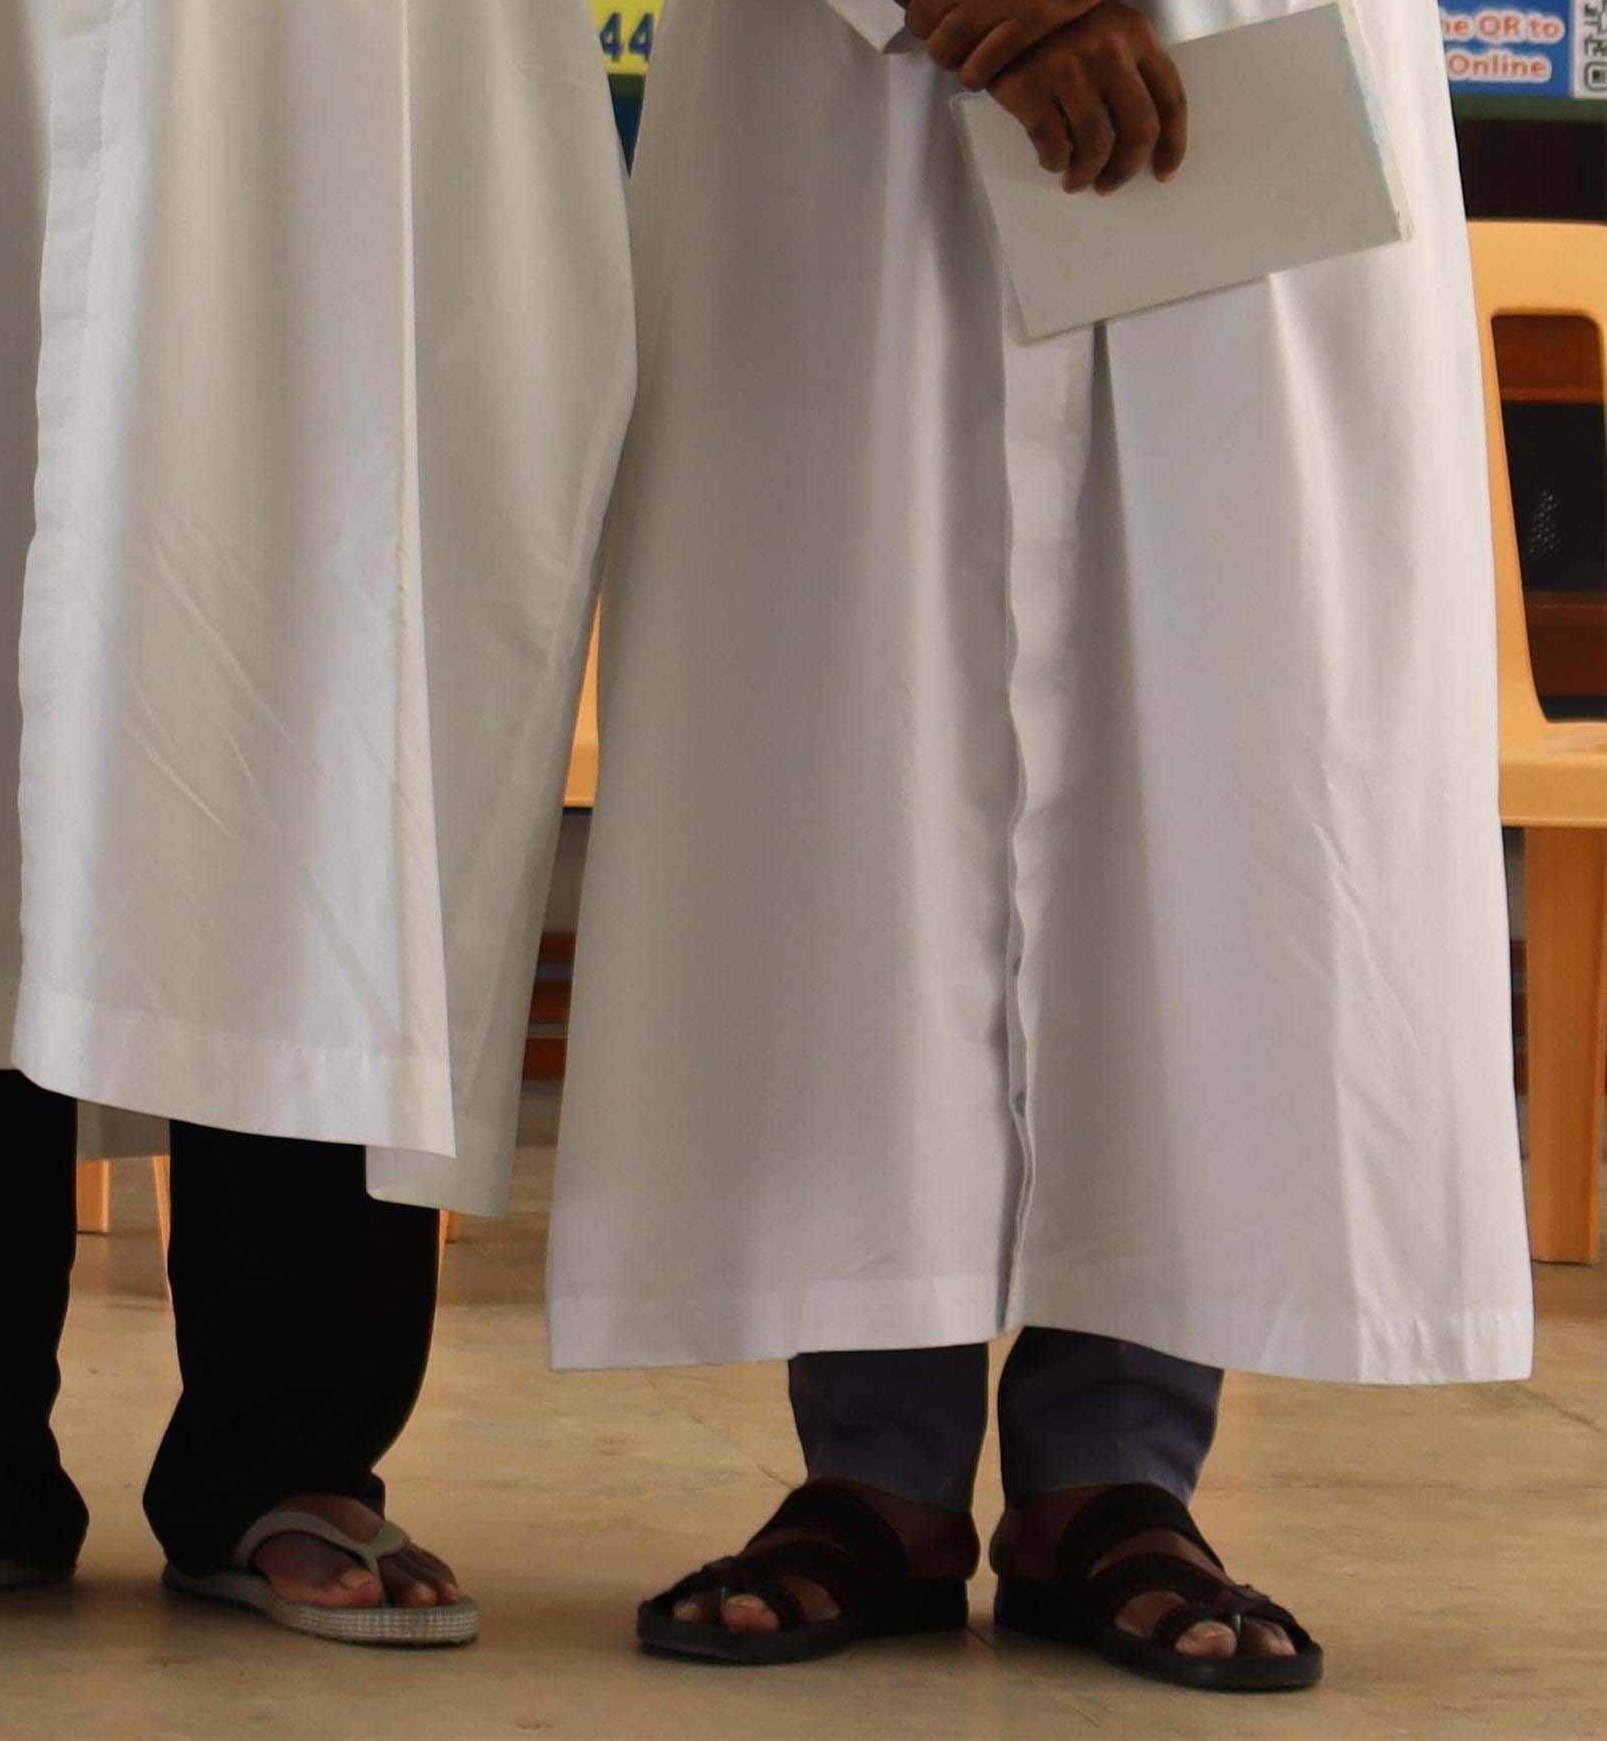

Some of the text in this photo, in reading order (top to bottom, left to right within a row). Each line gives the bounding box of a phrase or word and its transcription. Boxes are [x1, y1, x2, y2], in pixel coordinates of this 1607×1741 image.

[1478, 14, 1521, 39] QR
[1529, 16, 1561, 39] to
[1448, 53, 1547, 78] Online
